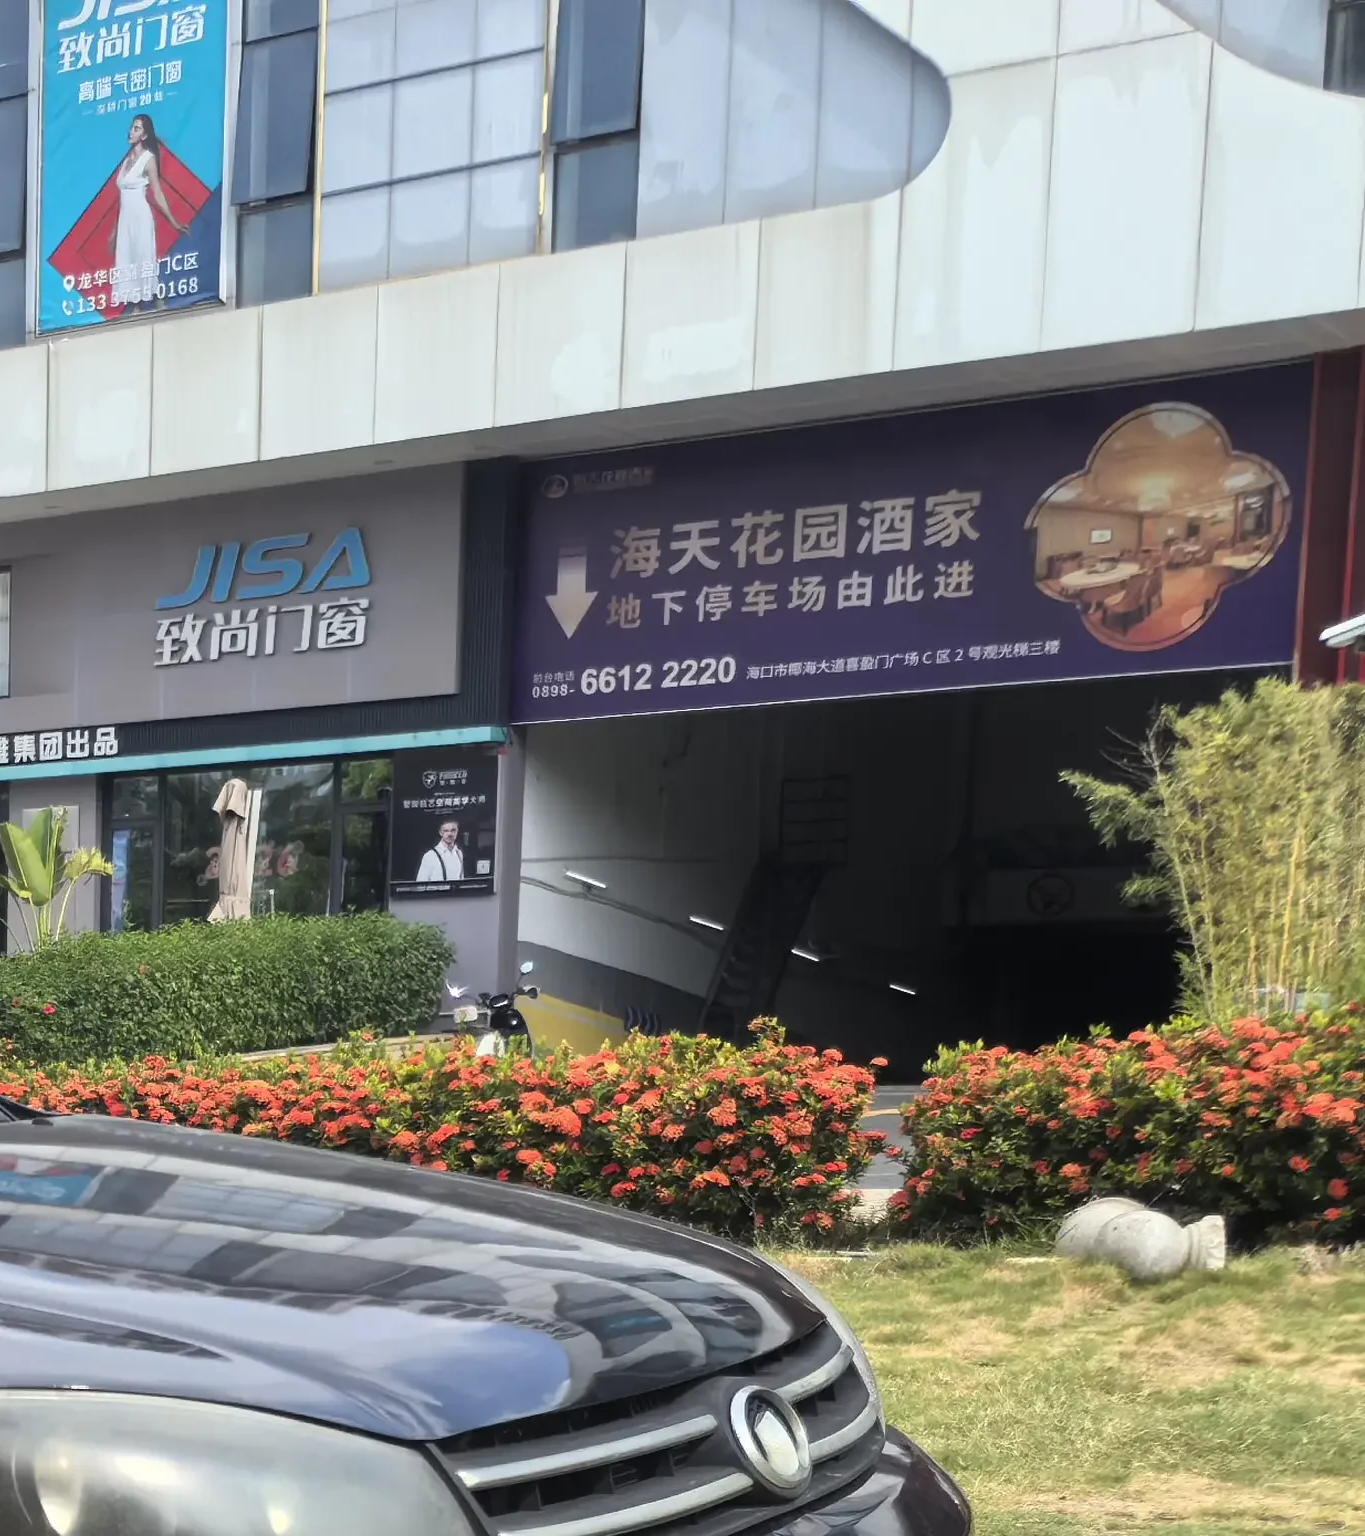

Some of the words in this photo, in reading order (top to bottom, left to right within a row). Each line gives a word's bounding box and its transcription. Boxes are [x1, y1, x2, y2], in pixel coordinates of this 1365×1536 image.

[56, 4, 206, 74] 致尚门窗
[78, 60, 182, 104] 高端气密门窗
[156, 277, 199, 300] 0168
[155, 526, 371, 610] JISA
[609, 489, 982, 579] 海天花园酒家
[606, 560, 975, 629] 地下停车场由此进
[154, 597, 370, 667] 致尚门窗
[532, 684, 576, 699] 0898-
[580, 662, 653, 696] 6612
[660, 656, 737, 688] 2220
